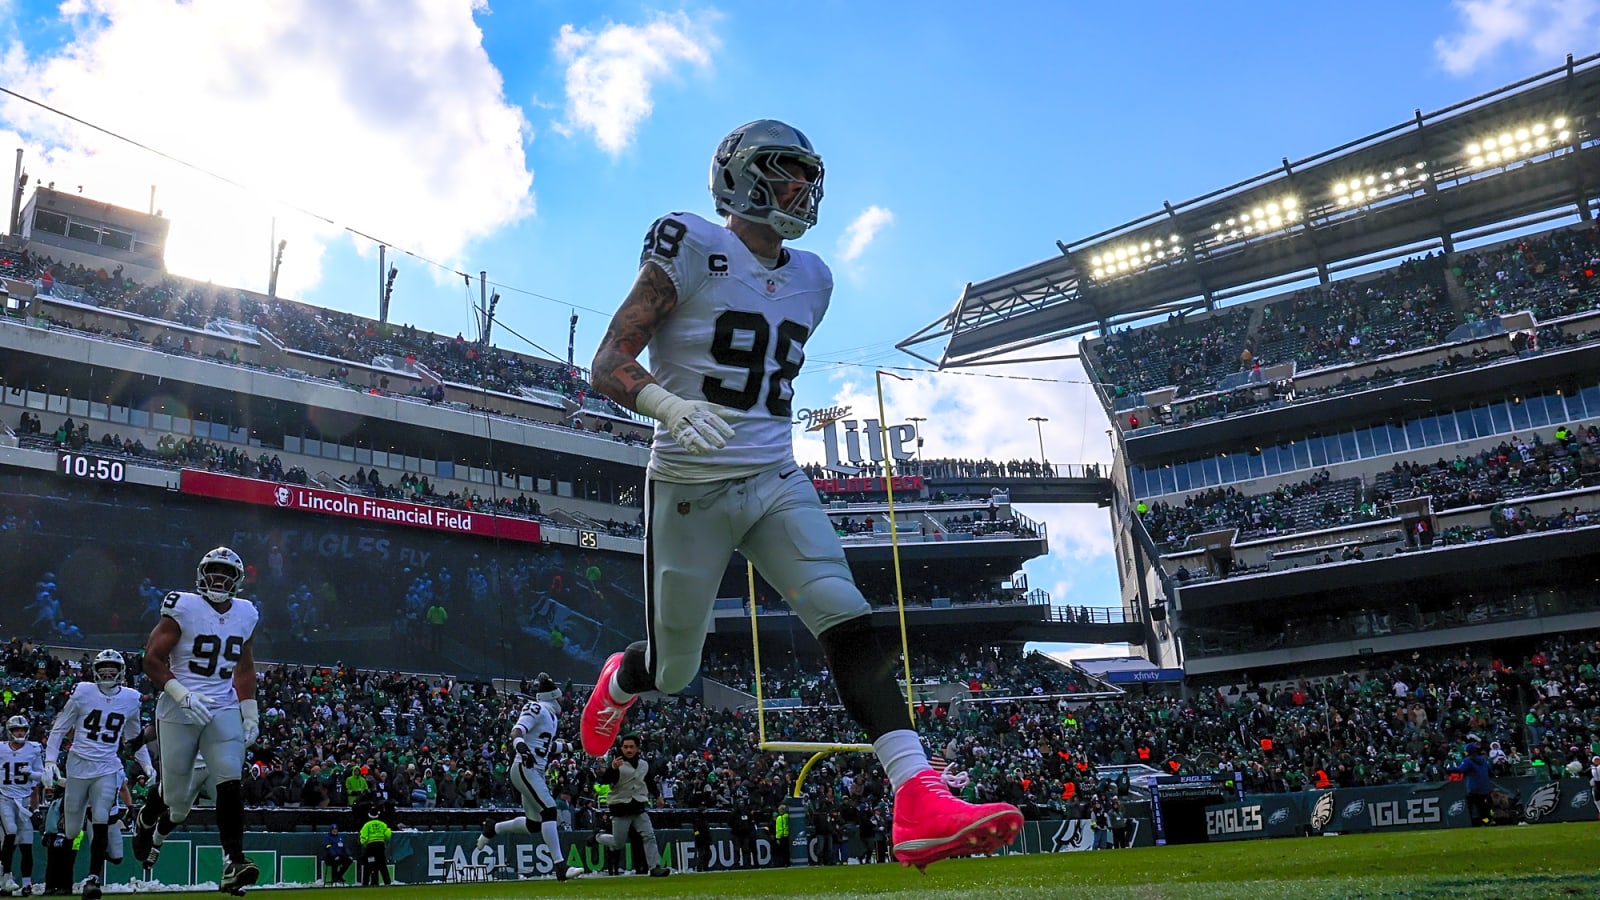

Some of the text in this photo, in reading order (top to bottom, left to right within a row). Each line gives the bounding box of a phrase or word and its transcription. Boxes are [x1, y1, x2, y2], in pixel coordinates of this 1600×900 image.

[708, 254, 729, 272] C
[702, 309, 810, 418] 98
[796, 405, 853, 429] Miller
[821, 418, 916, 476] Lite
[62, 454, 124, 482] 10:50
[299, 491, 473, 531] Lincoln Financial Field
[581, 532, 596, 547] 25
[188, 633, 244, 680] 99
[1133, 671, 1160, 681] xfinity
[83, 708, 126, 744] 49
[2, 761, 30, 785] 15
[1181, 774, 1212, 783] EAGLES
[1205, 804, 1263, 835] EAGLES
[427, 843, 554, 877] EAGLES
[566, 842, 673, 872] AUIM
